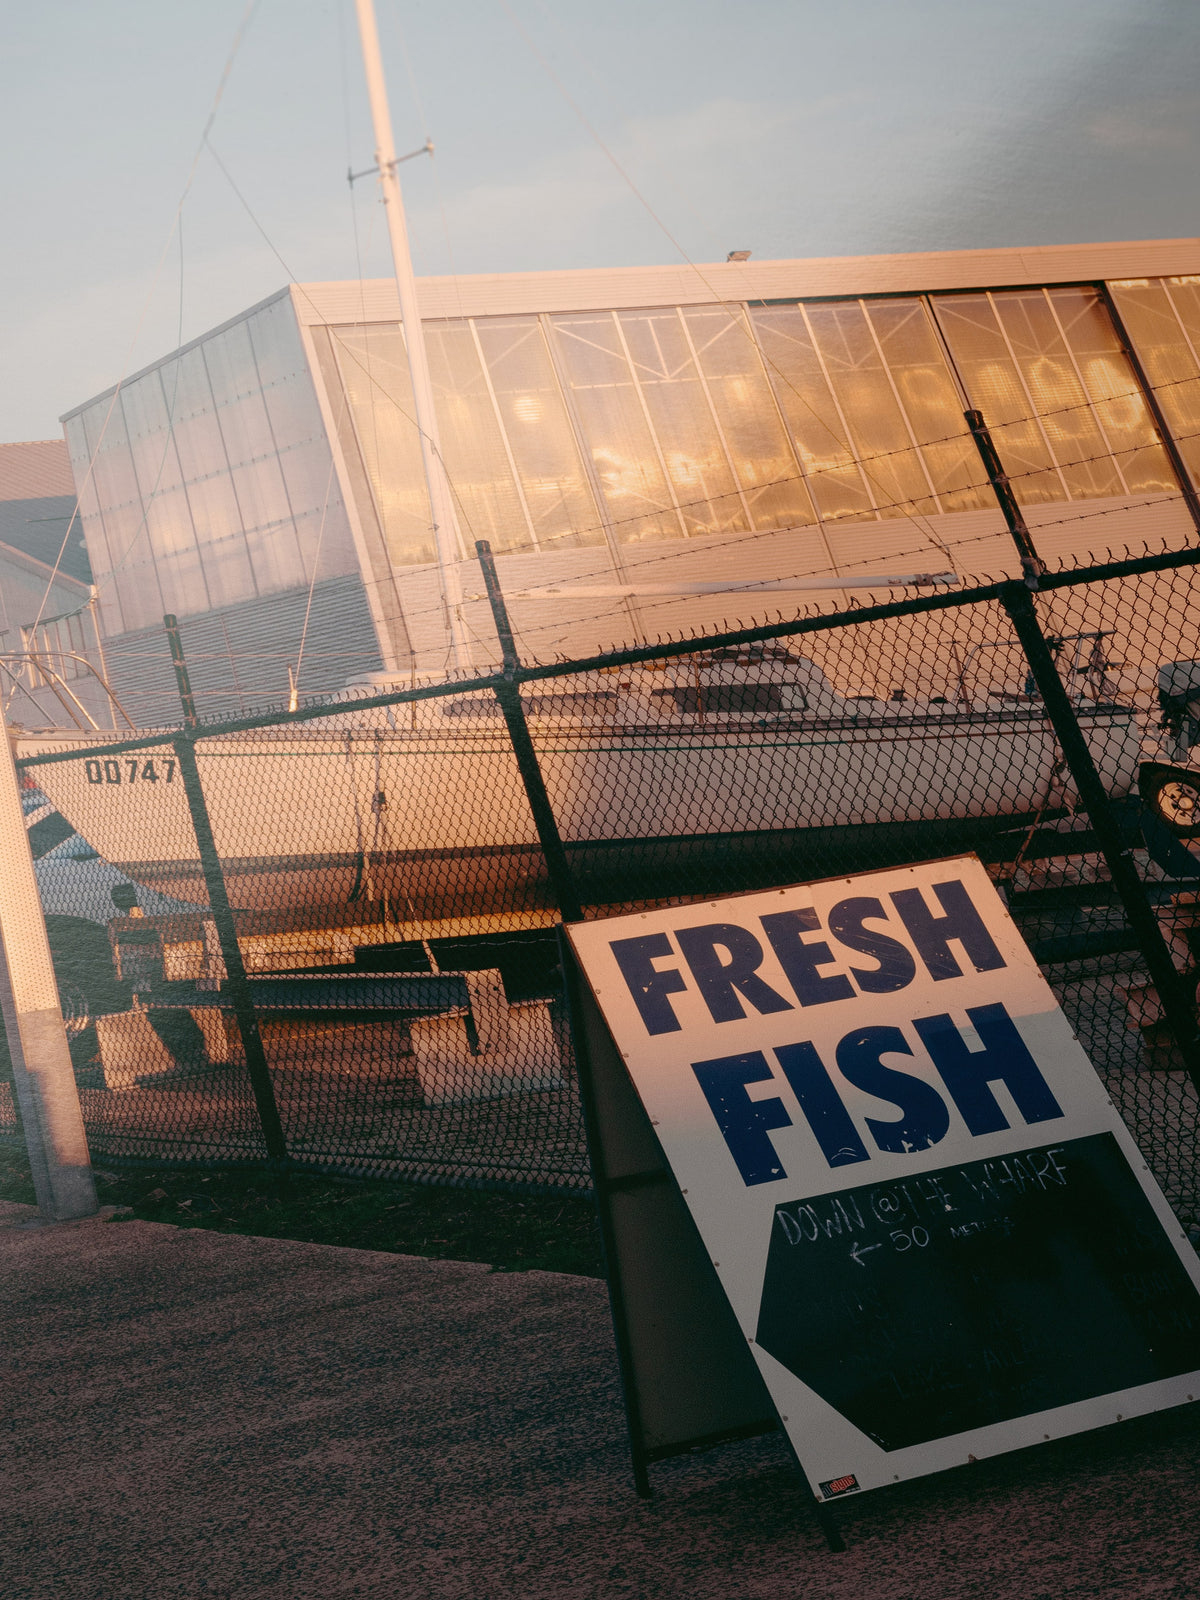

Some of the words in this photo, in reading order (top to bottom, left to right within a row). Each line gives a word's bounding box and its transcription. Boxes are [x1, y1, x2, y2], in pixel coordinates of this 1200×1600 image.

[609, 879, 1007, 1036] FRESH
[691, 1002, 1065, 1187] FISH
[776, 1195, 865, 1245] DOWN
[960, 1149, 1066, 1200] WHARF
[889, 1225, 930, 1252] 50
